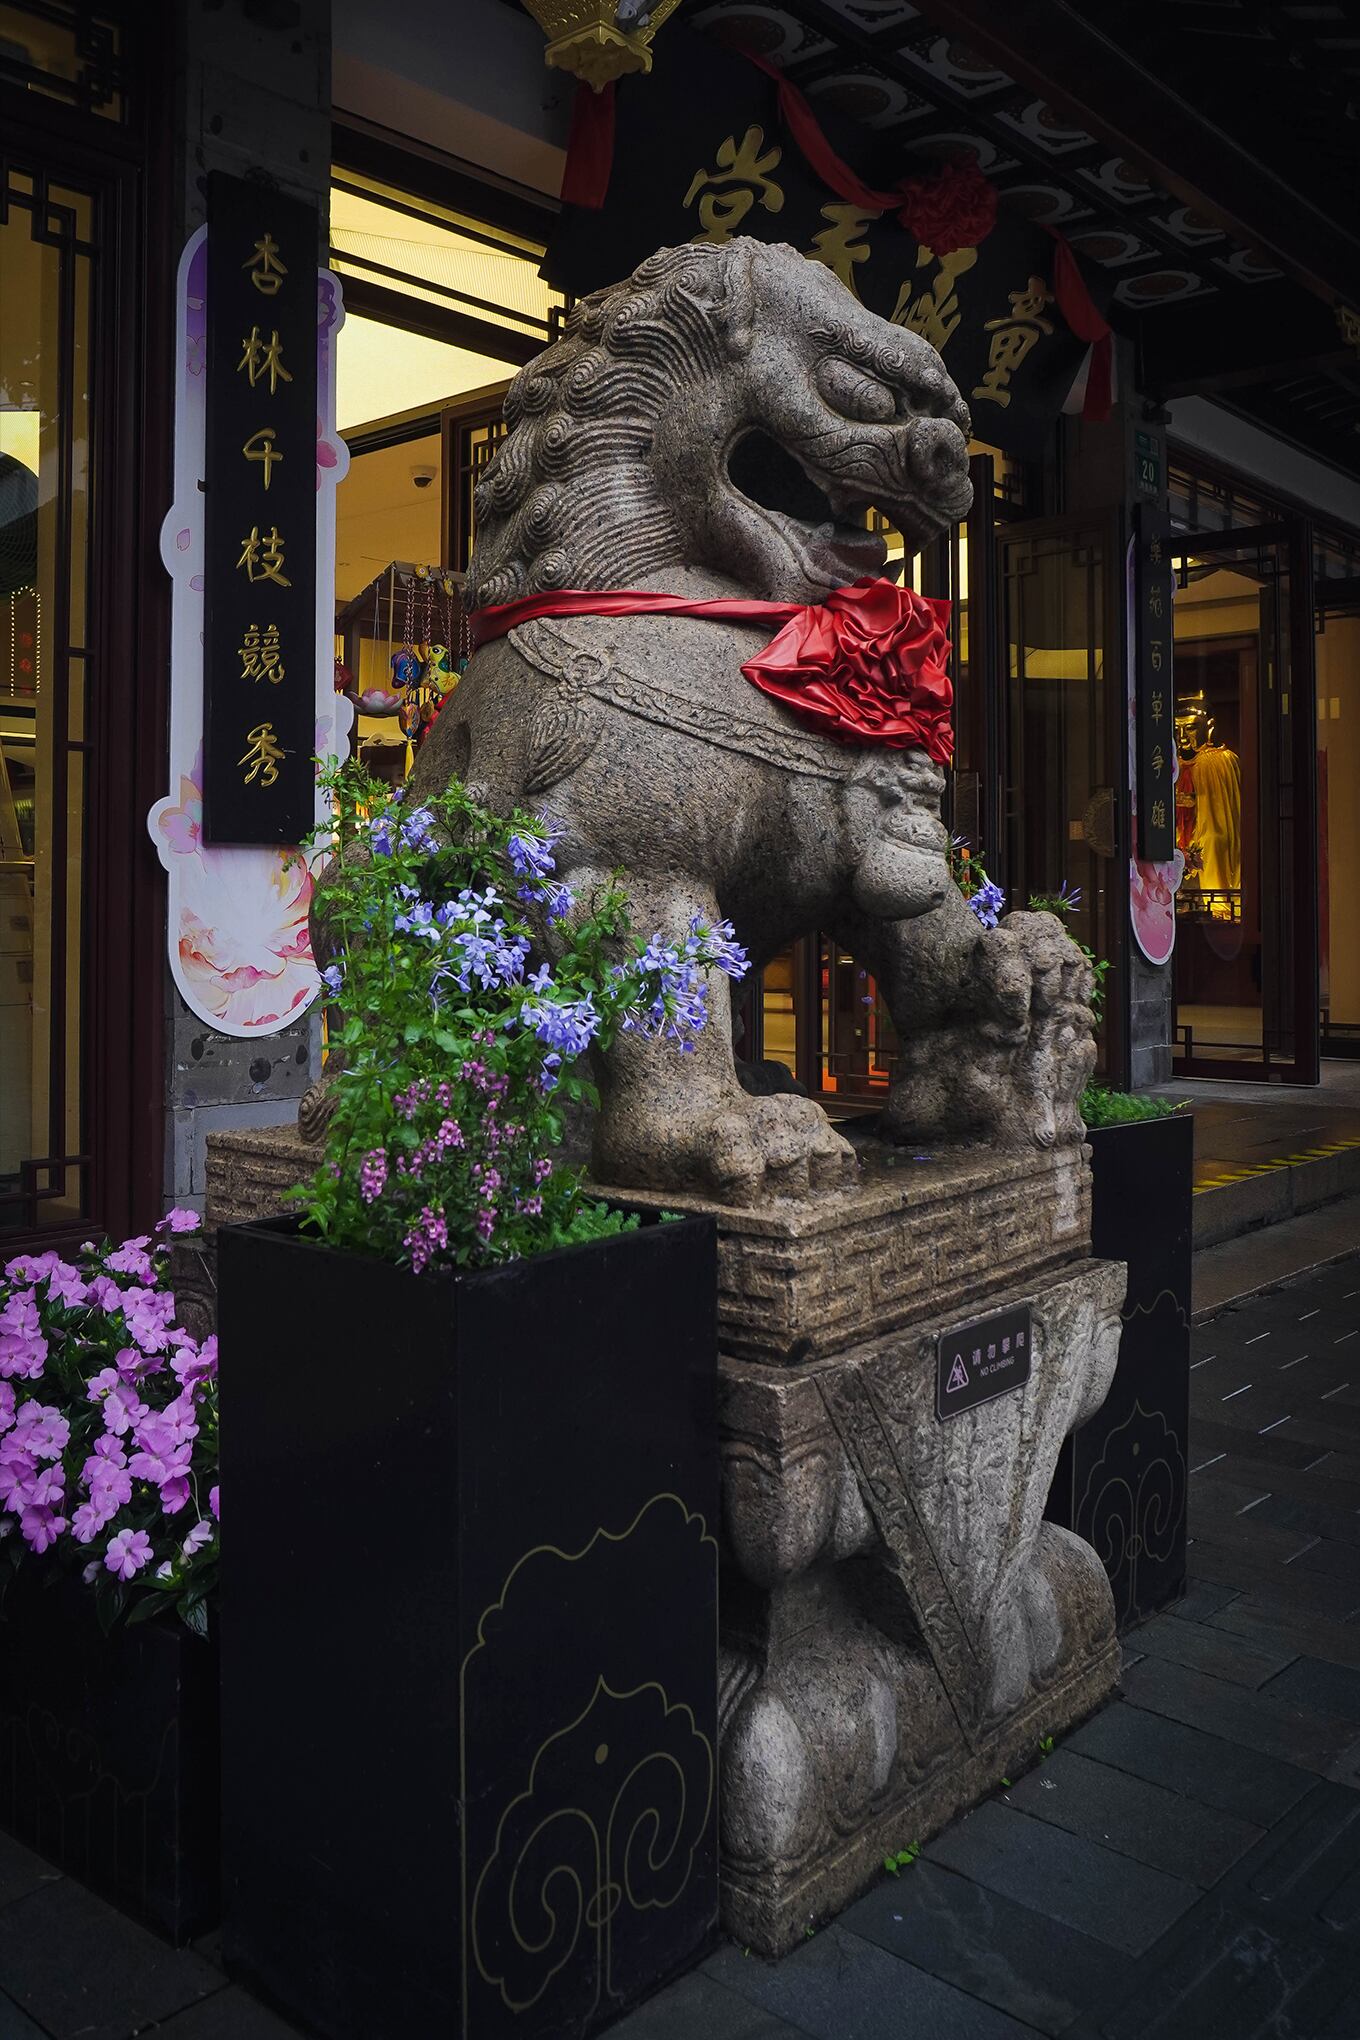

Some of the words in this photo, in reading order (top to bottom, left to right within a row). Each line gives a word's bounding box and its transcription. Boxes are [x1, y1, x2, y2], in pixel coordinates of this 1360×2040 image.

[1142, 459, 1155, 482] 20
[235, 231, 294, 788] 杏林千枝競秀
[980, 1366, 989, 1377] NO
[990, 1356, 1015, 1373] CLIMBING
